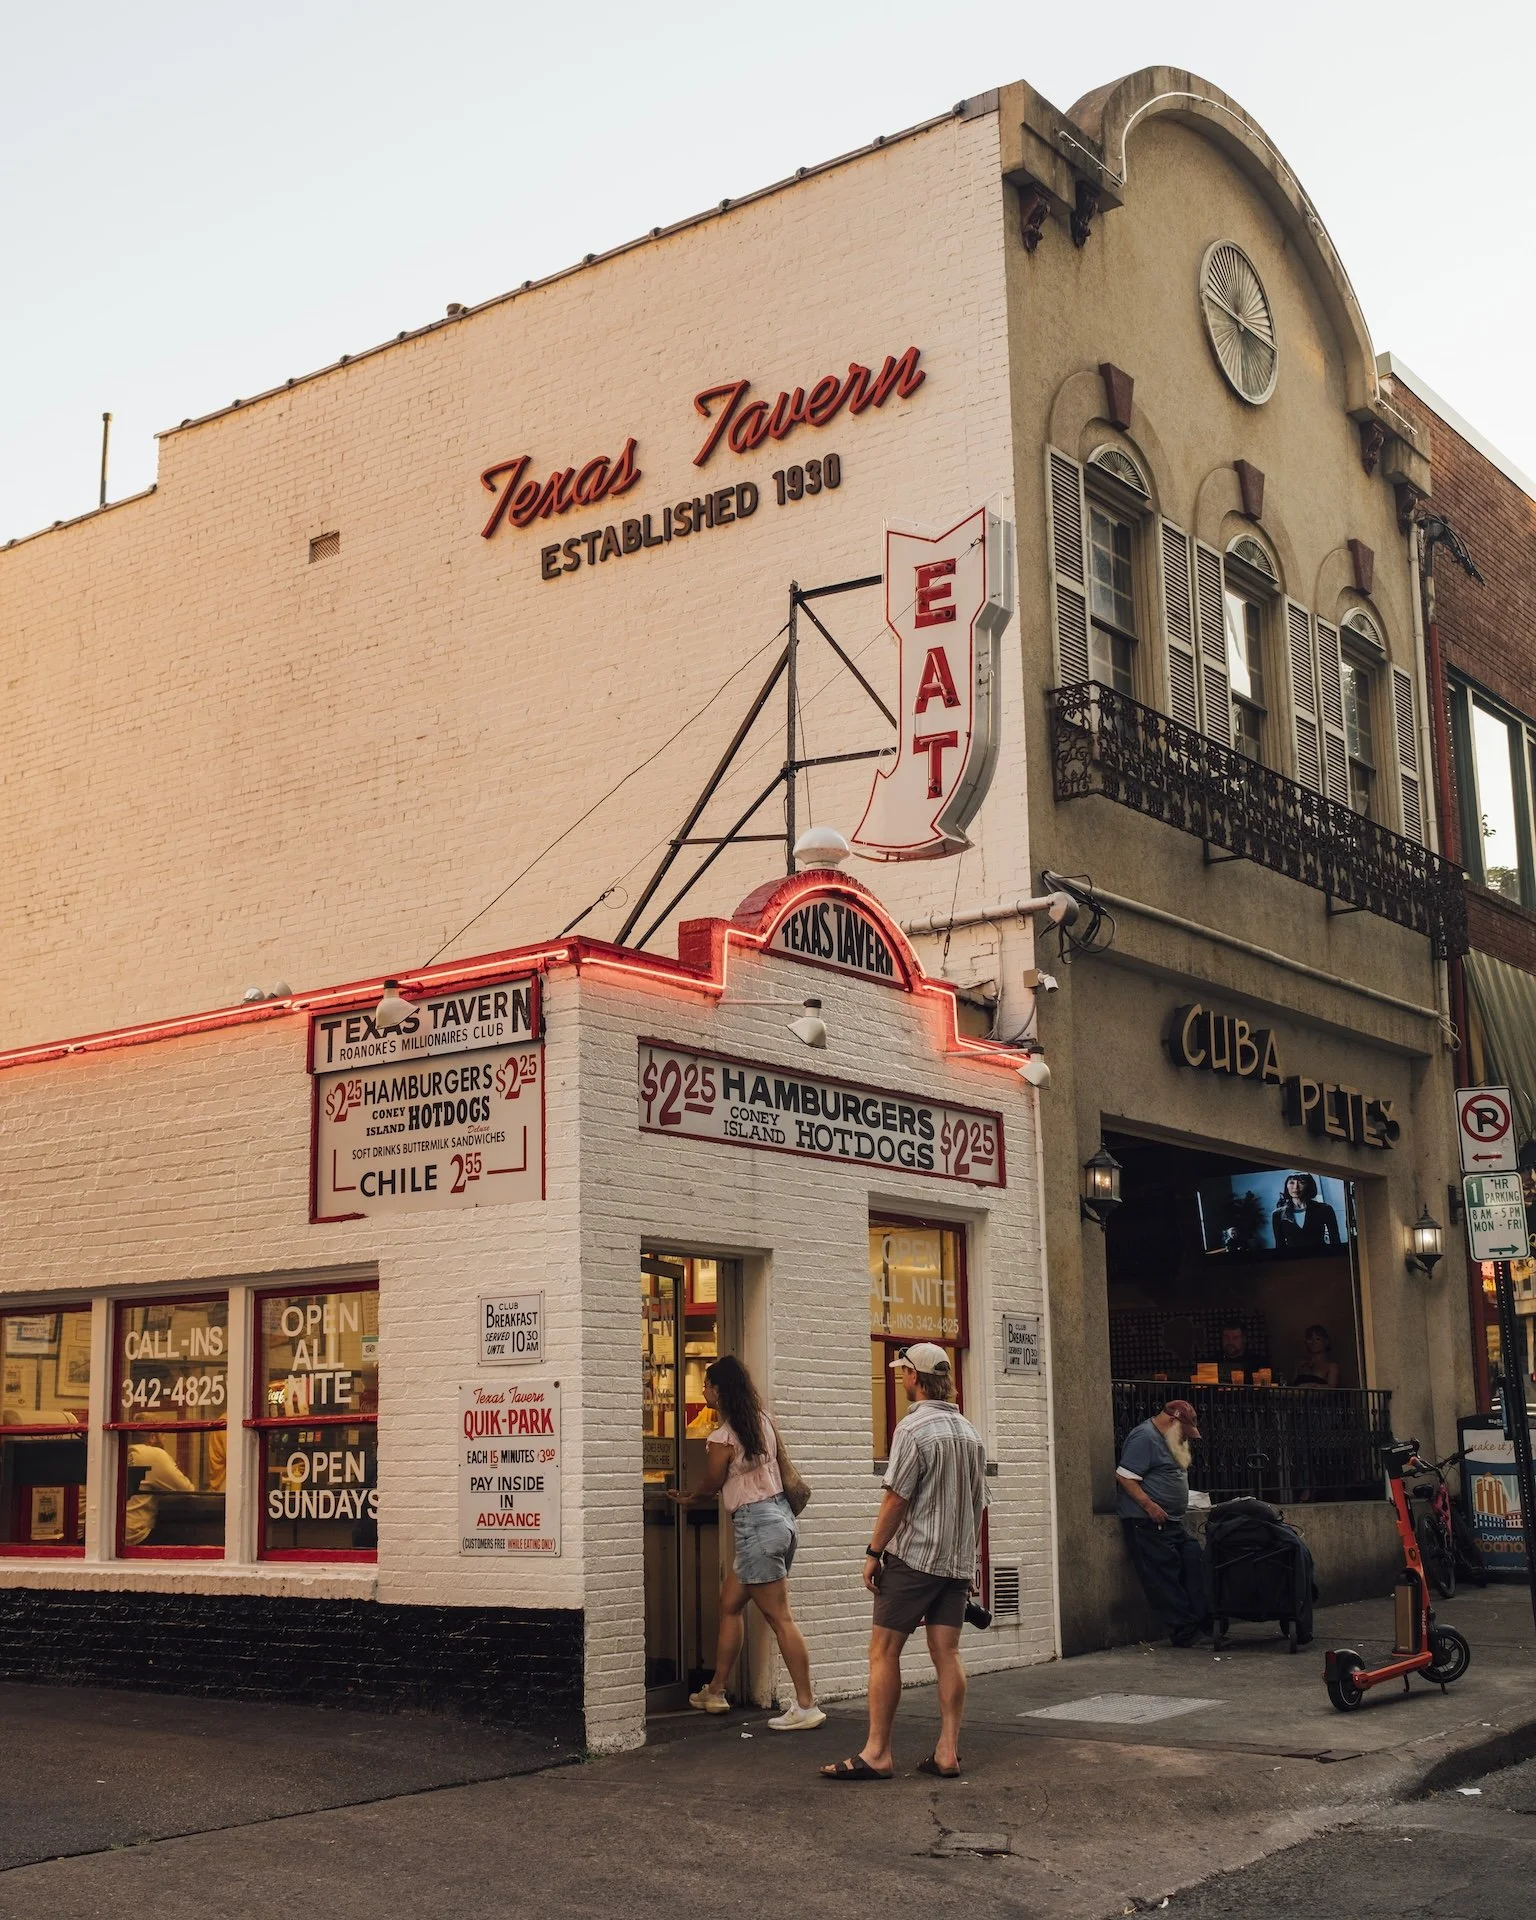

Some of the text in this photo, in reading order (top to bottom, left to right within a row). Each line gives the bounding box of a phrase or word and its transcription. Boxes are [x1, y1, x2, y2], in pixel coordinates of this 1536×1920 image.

[480, 346, 926, 539] Texas Tavern
[541, 453, 841, 580] ESTABLISHED 1930
[913, 558, 961, 799] EAT
[781, 902, 893, 976] TEXAS TAVERN
[428, 987, 532, 1033] TAVERN
[340, 1022, 503, 1061] ROANOKE'S MILLIONAIRES CLUB
[1180, 1003, 1284, 1085] CUBA
[364, 1064, 493, 1106] HAMBURGERS
[366, 1095, 490, 1136] ISLAND HOTDOGS
[372, 1107, 405, 1120] CONEY
[722, 1067, 935, 1140] HAMBURGERS
[730, 1107, 780, 1126] CONEY
[352, 1131, 506, 1160] SOFT DRINKS BUTTERMILK SANDWICHES
[723, 1119, 934, 1170] ISLAND HOTDOGS
[360, 1164, 438, 1197] CHILE
[1471, 1178, 1509, 1204] 1 HR
[1484, 1190, 1520, 1204] PARKING
[1472, 1209, 1478, 1220] 8
[1480, 1208, 1493, 1219] AM
[1501, 1207, 1507, 1218] 5
[1509, 1206, 1521, 1217] PM
[1474, 1221, 1494, 1232] MON
[1508, 1219, 1522, 1230] FRI
[881, 1235, 940, 1268] OPEN
[498, 1302, 519, 1311] CLUB
[912, 1277, 956, 1309] NITE
[281, 1301, 359, 1337] OPEN
[486, 1304, 538, 1328] BREAKFAST
[871, 1312, 960, 1334] ALL-INS 342-4825
[484, 1331, 510, 1342] SERVED
[486, 1342, 539, 1355] UNTIL AM
[1008, 1323, 1037, 1345] BREAKFAST
[292, 1338, 344, 1372] ALL
[121, 1375, 225, 1408] 342-4825
[287, 1371, 352, 1408] NITE
[473, 1385, 545, 1404] Texas Tavern
[464, 1408, 555, 1440] QUIK-PARK
[286, 1451, 366, 1484] OPEN
[467, 1450, 488, 1464] EACH
[490, 1450, 499, 1464] 15
[501, 1449, 535, 1463] MINUTES
[470, 1476, 544, 1491] PAY INSIDE
[268, 1489, 379, 1520] SUNDAYS
[500, 1494, 514, 1509] IN
[476, 1513, 541, 1527] ADVANCE
[494, 1538, 506, 1549] FREE
[507, 1538, 523, 1549] WHILE
[523, 1538, 540, 1549] EATING
[1475, 1538, 1528, 1553] Roano
[1482, 1532, 1524, 1542] Downtown
